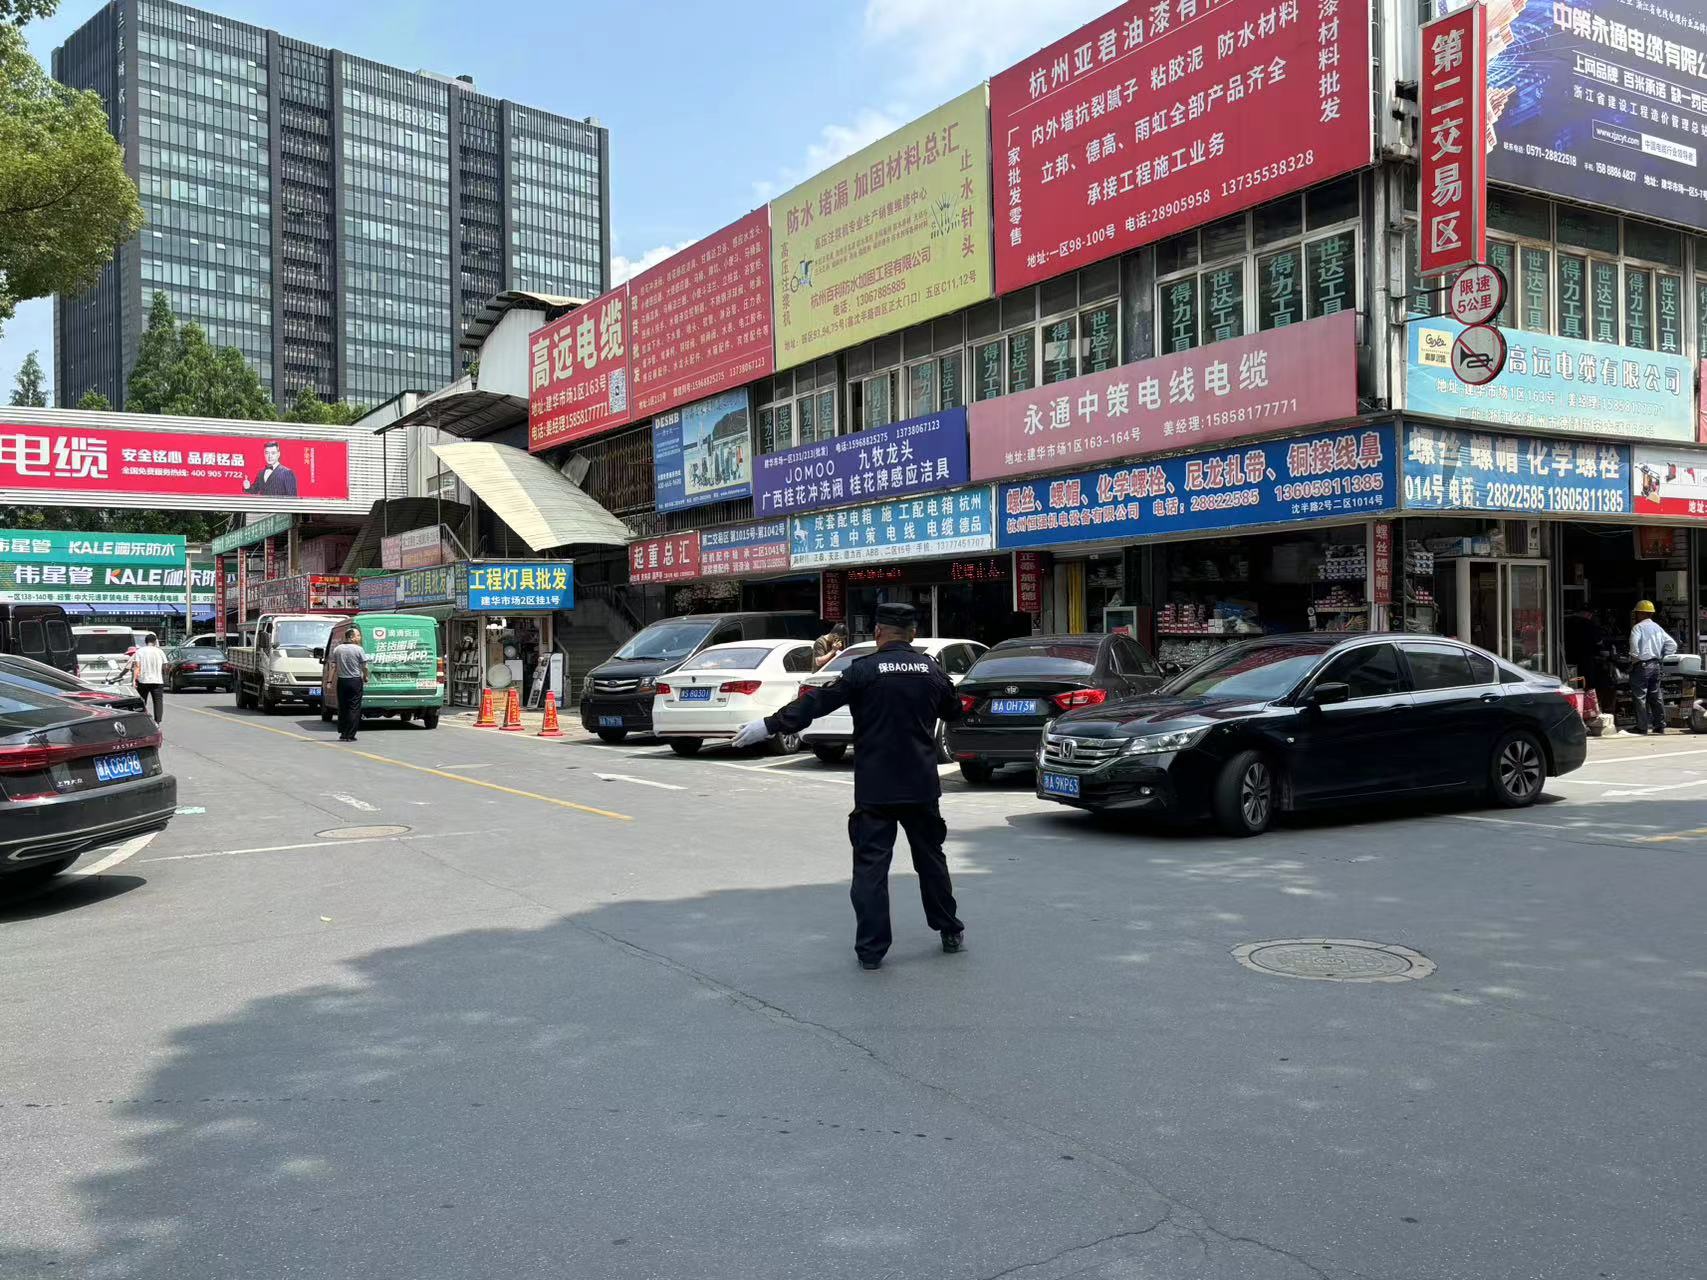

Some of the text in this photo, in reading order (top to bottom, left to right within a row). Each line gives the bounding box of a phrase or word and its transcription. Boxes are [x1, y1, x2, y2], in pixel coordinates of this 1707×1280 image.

[1031, 0, 1299, 148] 内外墙抗裂腻子 粘胶泥 防水材料
[1573, 54, 1618, 84] 上网品牌
[1624, 70, 1666, 100] 百米承诺
[1431, 28, 1464, 254] 第二交易区
[787, 199, 814, 236] 防水
[854, 122, 960, 200] 加固材料总汇
[1006, 126, 1022, 248] 厂家批发零售
[1087, 132, 1225, 207] 承接工程施工业务
[960, 149, 974, 258] 止水针头
[1026, 149, 1314, 268] 地址:一区98-100号 电话:28905958 13735538328
[1458, 295, 1492, 314] 5公里
[1460, 274, 1491, 297] 限速
[1527, 252, 1544, 328] 世达工具
[1562, 259, 1582, 338] 得力工具
[1596, 266, 1614, 342] 世达工具
[1629, 272, 1644, 348] 得力工具
[1660, 278, 1676, 352] 世达工具
[532, 298, 624, 392] 高远电缆
[729, 357, 764, 376] 13738067123
[1508, 344, 1680, 398] 高远电缆有限公司
[1024, 349, 1268, 436] 永通中策电线电缆
[0, 434, 108, 479] 电缆
[836, 432, 888, 453] 电话:15968825275
[896, 420, 940, 438] 13738067123
[859, 439, 913, 470] 九牧龙头
[1004, 398, 1298, 465] 地址:建华市场1区163-164号 姜经理:15858177771
[1408, 427, 1620, 480] 螺丝 螺帽 化学螺栓
[191, 470, 205, 478] 400
[208, 470, 221, 478] 905
[762, 477, 844, 510] 广西桂花冲洗阀
[850, 457, 950, 496] 桂花牌感应洁具
[785, 460, 835, 484] JOMOO
[814, 508, 872, 531] 成套配电箱
[959, 493, 981, 512] 杭州
[1007, 502, 1140, 534] 杭州恒强机电设备有限公司
[1274, 473, 1384, 502] 13605811385
[1291, 494, 1383, 514] 沈半路2号二区1014号
[1548, 487, 1624, 512] 13605811385
[634, 540, 690, 569] 起重总汇
[702, 531, 730, 546] 第二交易区
[814, 516, 981, 549] 元通 中策 电线 电缆 德品
[14, 565, 94, 585] 伟星管
[470, 568, 567, 590] 工程灯具批发
[481, 596, 560, 606] 建华市场2区挂1号
